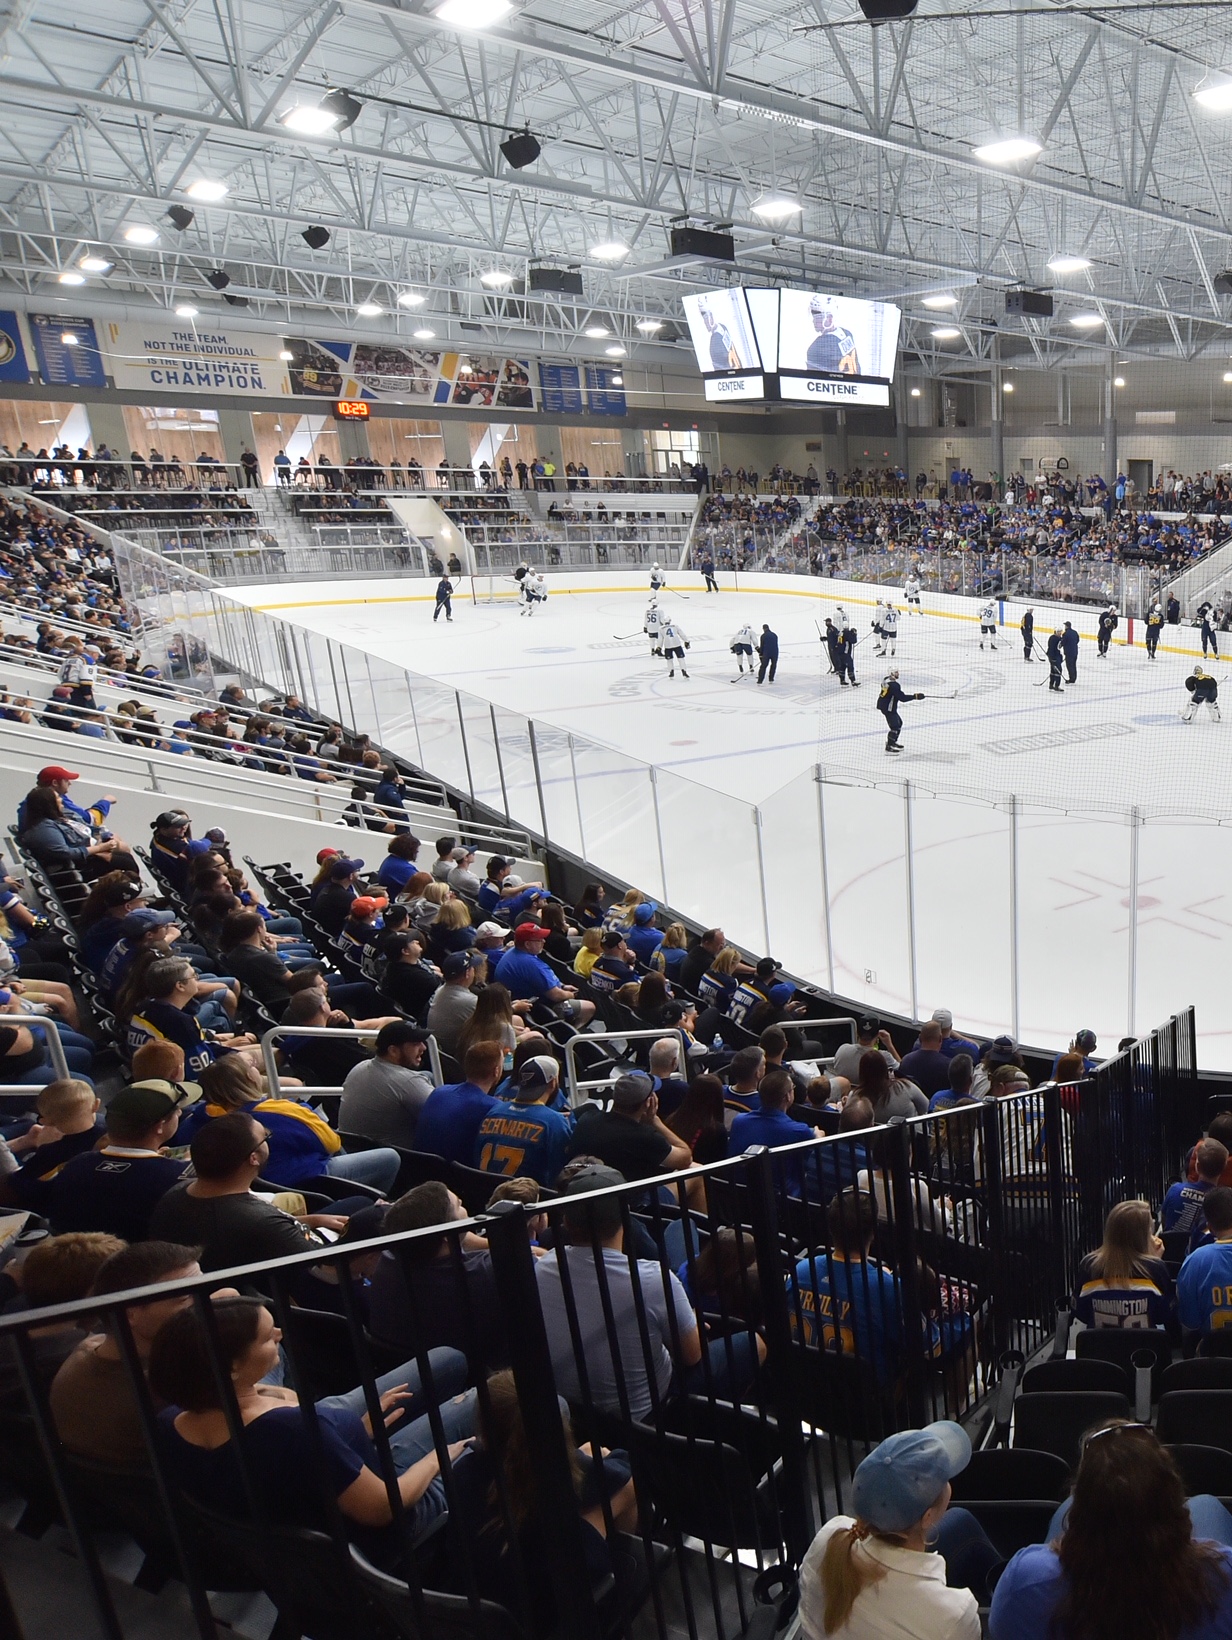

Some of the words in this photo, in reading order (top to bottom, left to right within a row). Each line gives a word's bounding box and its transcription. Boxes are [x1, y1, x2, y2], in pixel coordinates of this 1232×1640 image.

[172, 332, 194, 342] THE
[144, 340, 167, 350] NOT
[169, 342, 191, 352] THE
[194, 344, 259, 357] INDIVIDUAL.
[159, 358, 179, 366] THE
[182, 360, 261, 375] ULTIMATE
[151, 370, 266, 390] CHAMPION.
[718, 380, 745, 393] CENTENE
[807, 381, 858, 396] CENTENE
[338, 403, 368, 415] 10:29
[646, 613, 657, 623] 56
[885, 613, 897, 623] 47
[666, 628, 674, 637] 4
[479, 1117, 545, 1142] SCHWARTZ
[479, 1143, 526, 1177] 17
